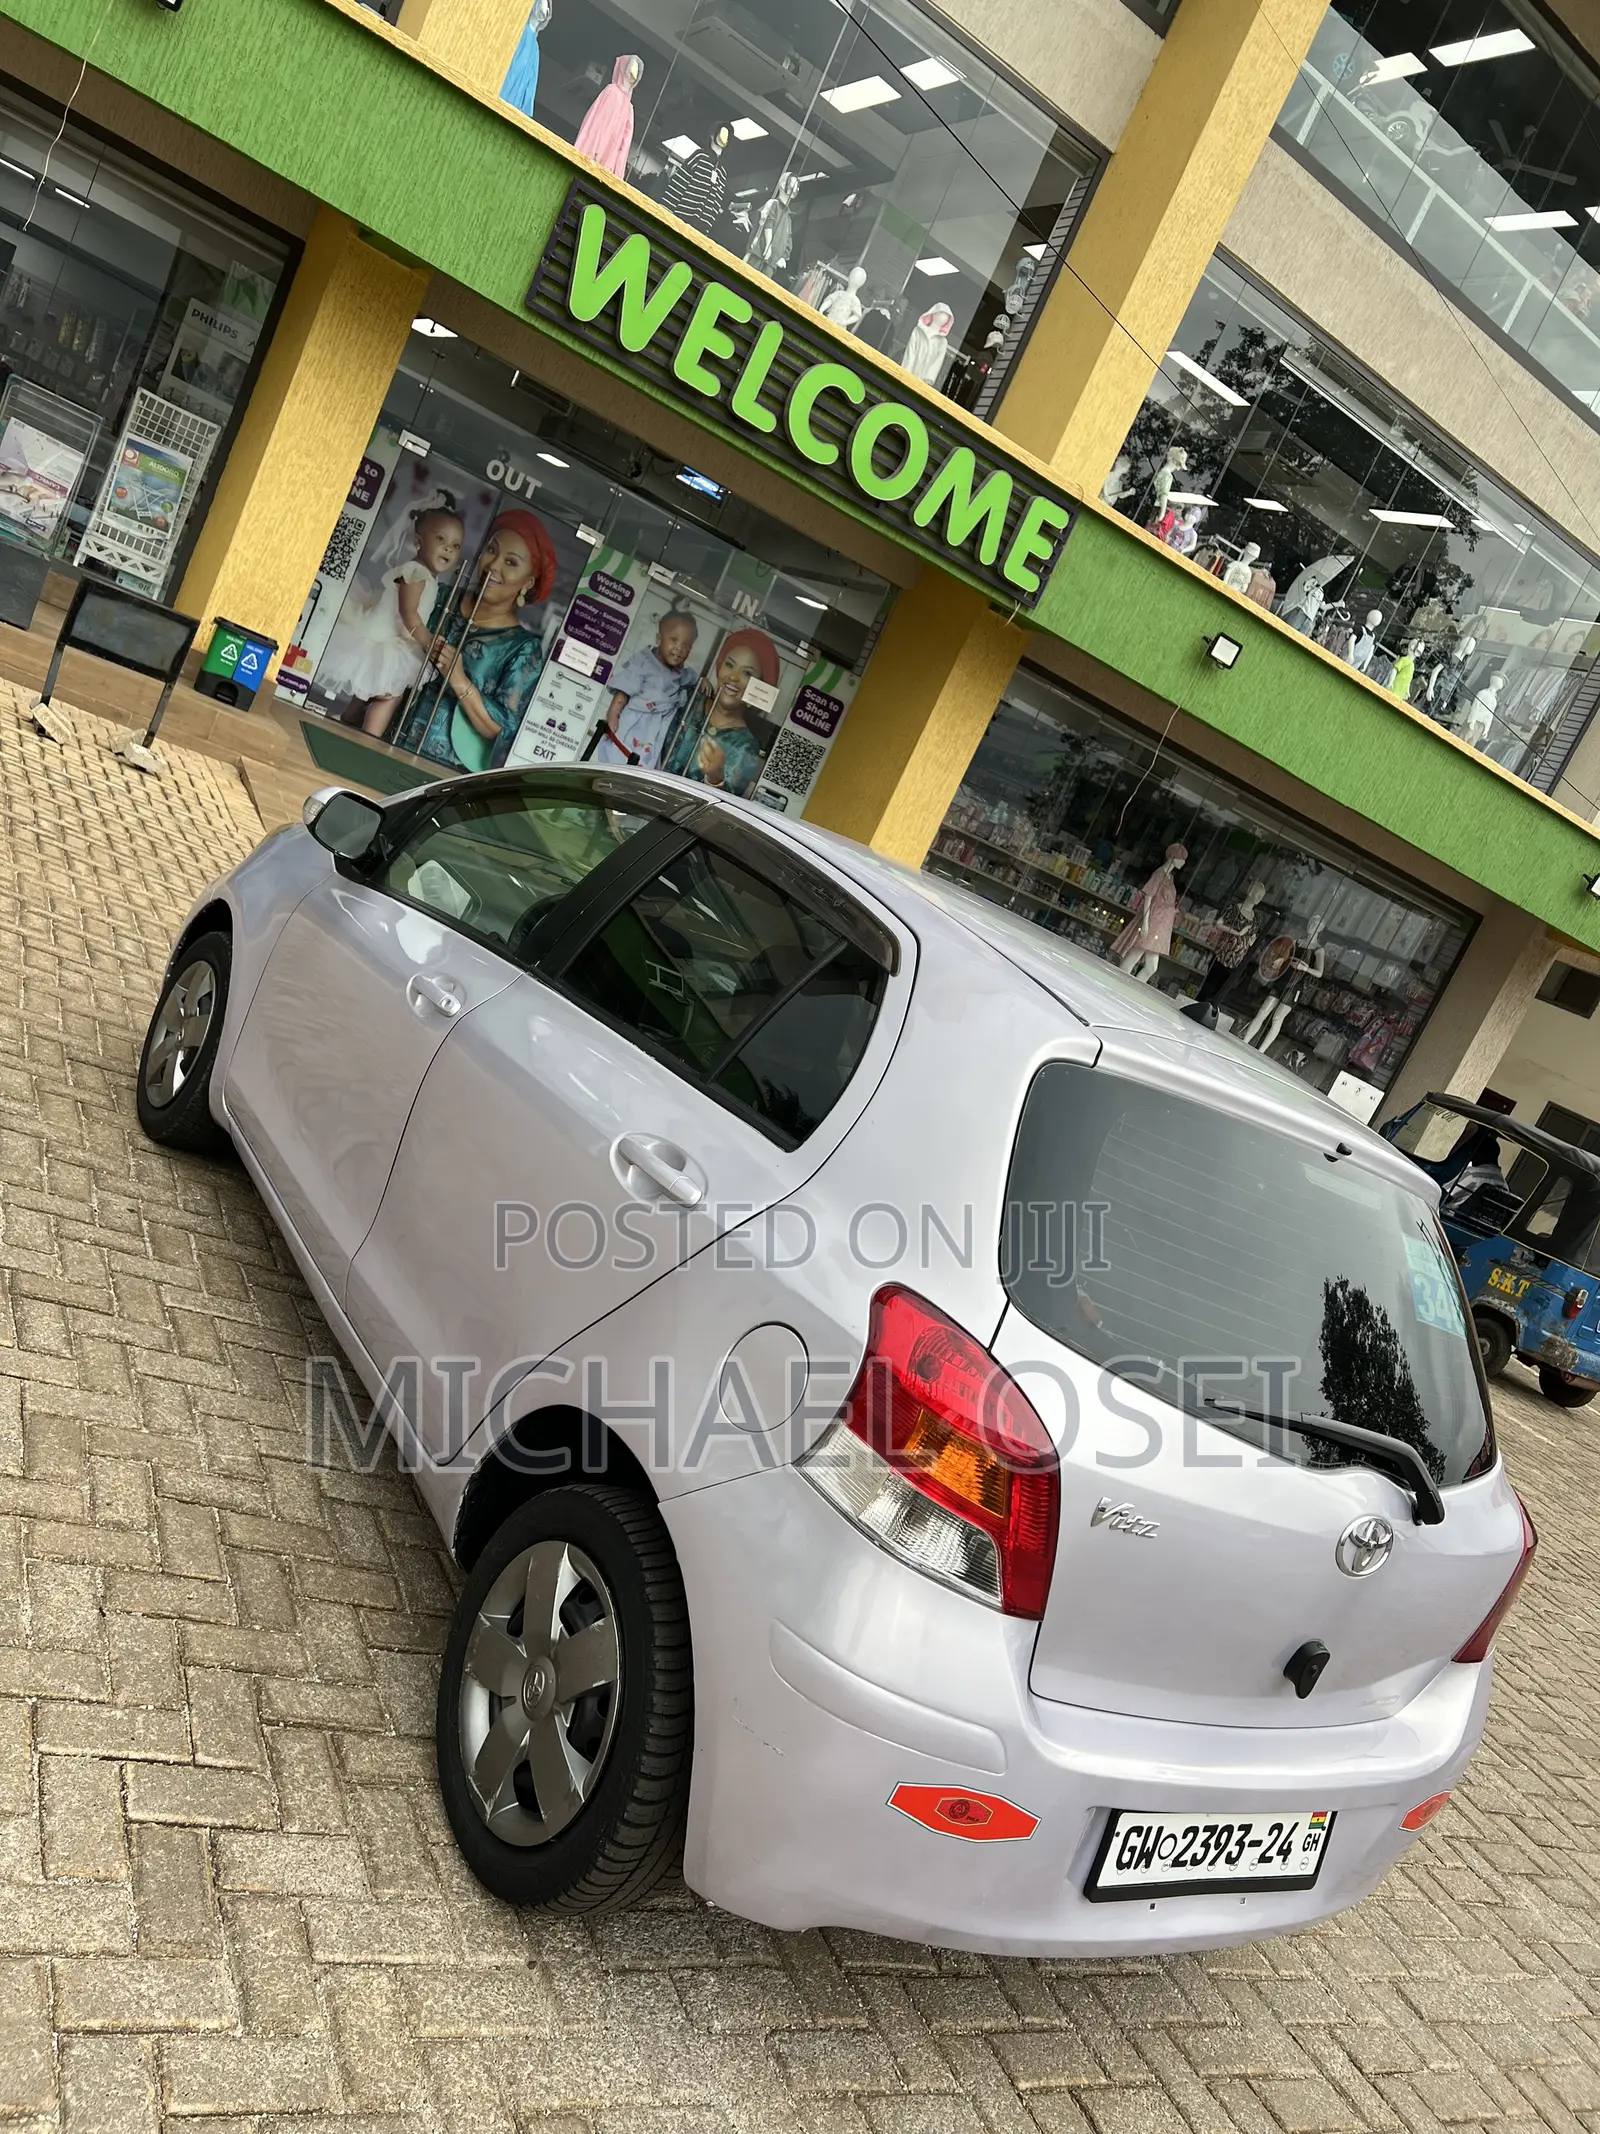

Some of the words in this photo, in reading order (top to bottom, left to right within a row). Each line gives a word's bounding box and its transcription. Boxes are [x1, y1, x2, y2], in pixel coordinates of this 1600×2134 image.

[191, 308, 239, 339] PHILIPS
[567, 203, 1070, 594] WELCOME
[364, 463, 379, 478] to
[486, 457, 544, 501] OUT
[597, 573, 631, 598] Working
[598, 584, 623, 602] Hours
[731, 589, 760, 618] IN
[804, 688, 828, 707] Scan
[828, 701, 840, 712] to
[805, 701, 830, 720] Shop
[795, 709, 832, 732] ONLINE
[533, 745, 556, 761] EXIT
[1090, 1496, 1161, 1538] Vitz
[1170, 1821, 1300, 1868] 2393-24
[1302, 1832, 1322, 1852] GH
